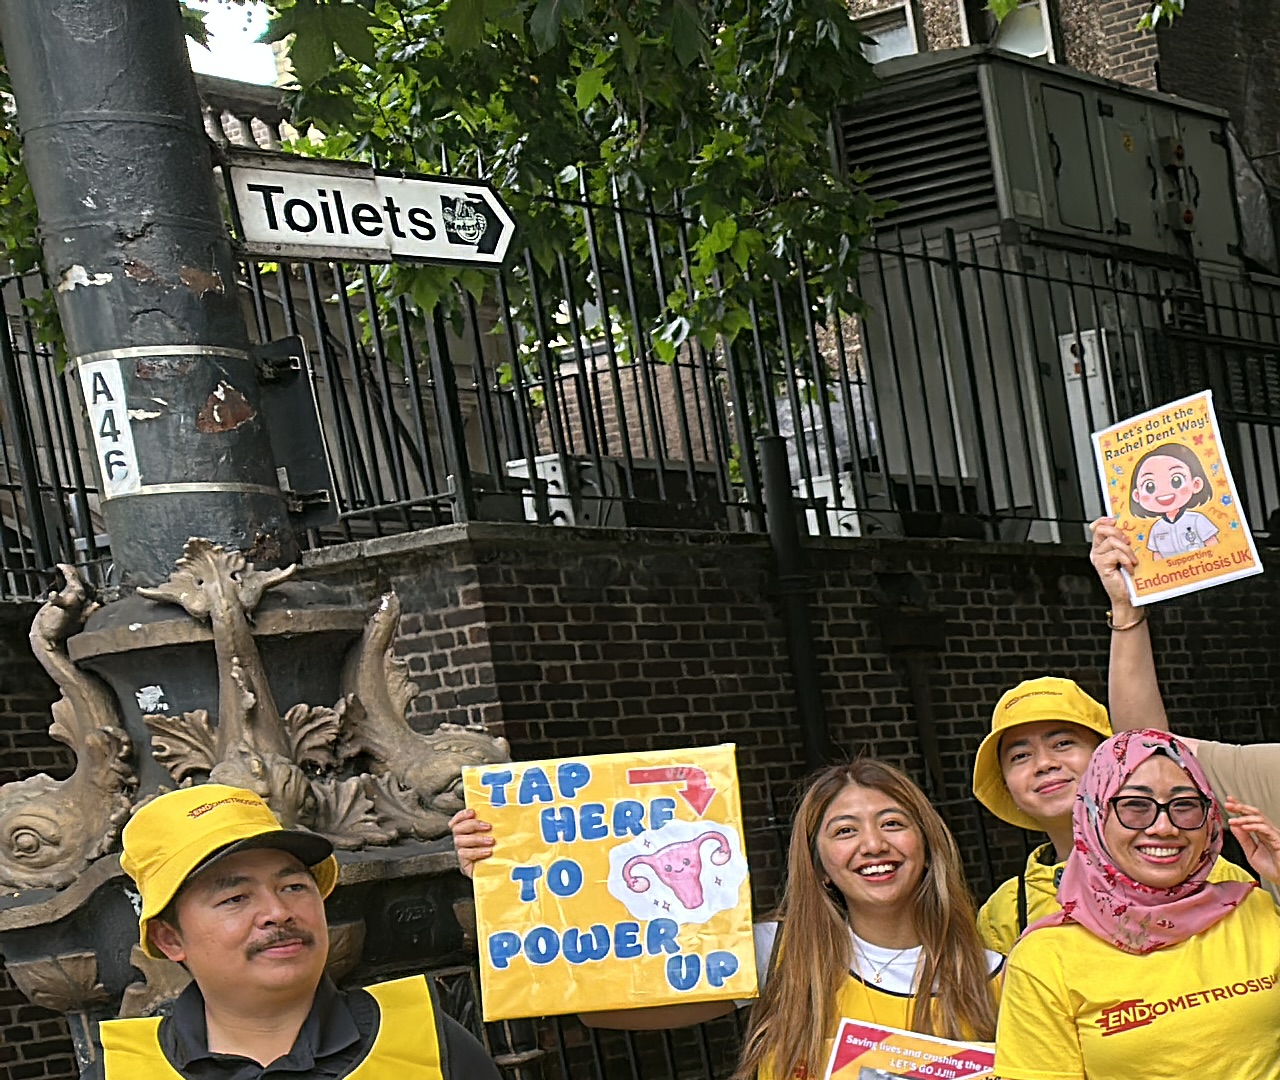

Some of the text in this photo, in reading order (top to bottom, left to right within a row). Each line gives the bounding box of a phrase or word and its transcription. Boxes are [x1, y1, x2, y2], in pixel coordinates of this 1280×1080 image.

[247, 183, 437, 242] Toilets
[1105, 412, 1209, 461] Rachel Dent Way!
[1116, 408, 1193, 442] Let's do it the
[1135, 549, 1252, 591] Endometriosis UK
[1166, 549, 1213, 568] Supporting
[481, 762, 591, 807] TAP
[540, 798, 676, 843] HERE
[511, 859, 583, 902] TO
[488, 918, 681, 969] POWER
[665, 951, 739, 991] UP
[846, 1034, 878, 1051] Saving
[879, 1041, 901, 1055] lives
[902, 1046, 922, 1060] and
[923, 1052, 963, 1069] crushing
[964, 1059, 982, 1071] the
[889, 1058, 917, 1072] LET'S
[918, 1064, 934, 1076] GO
